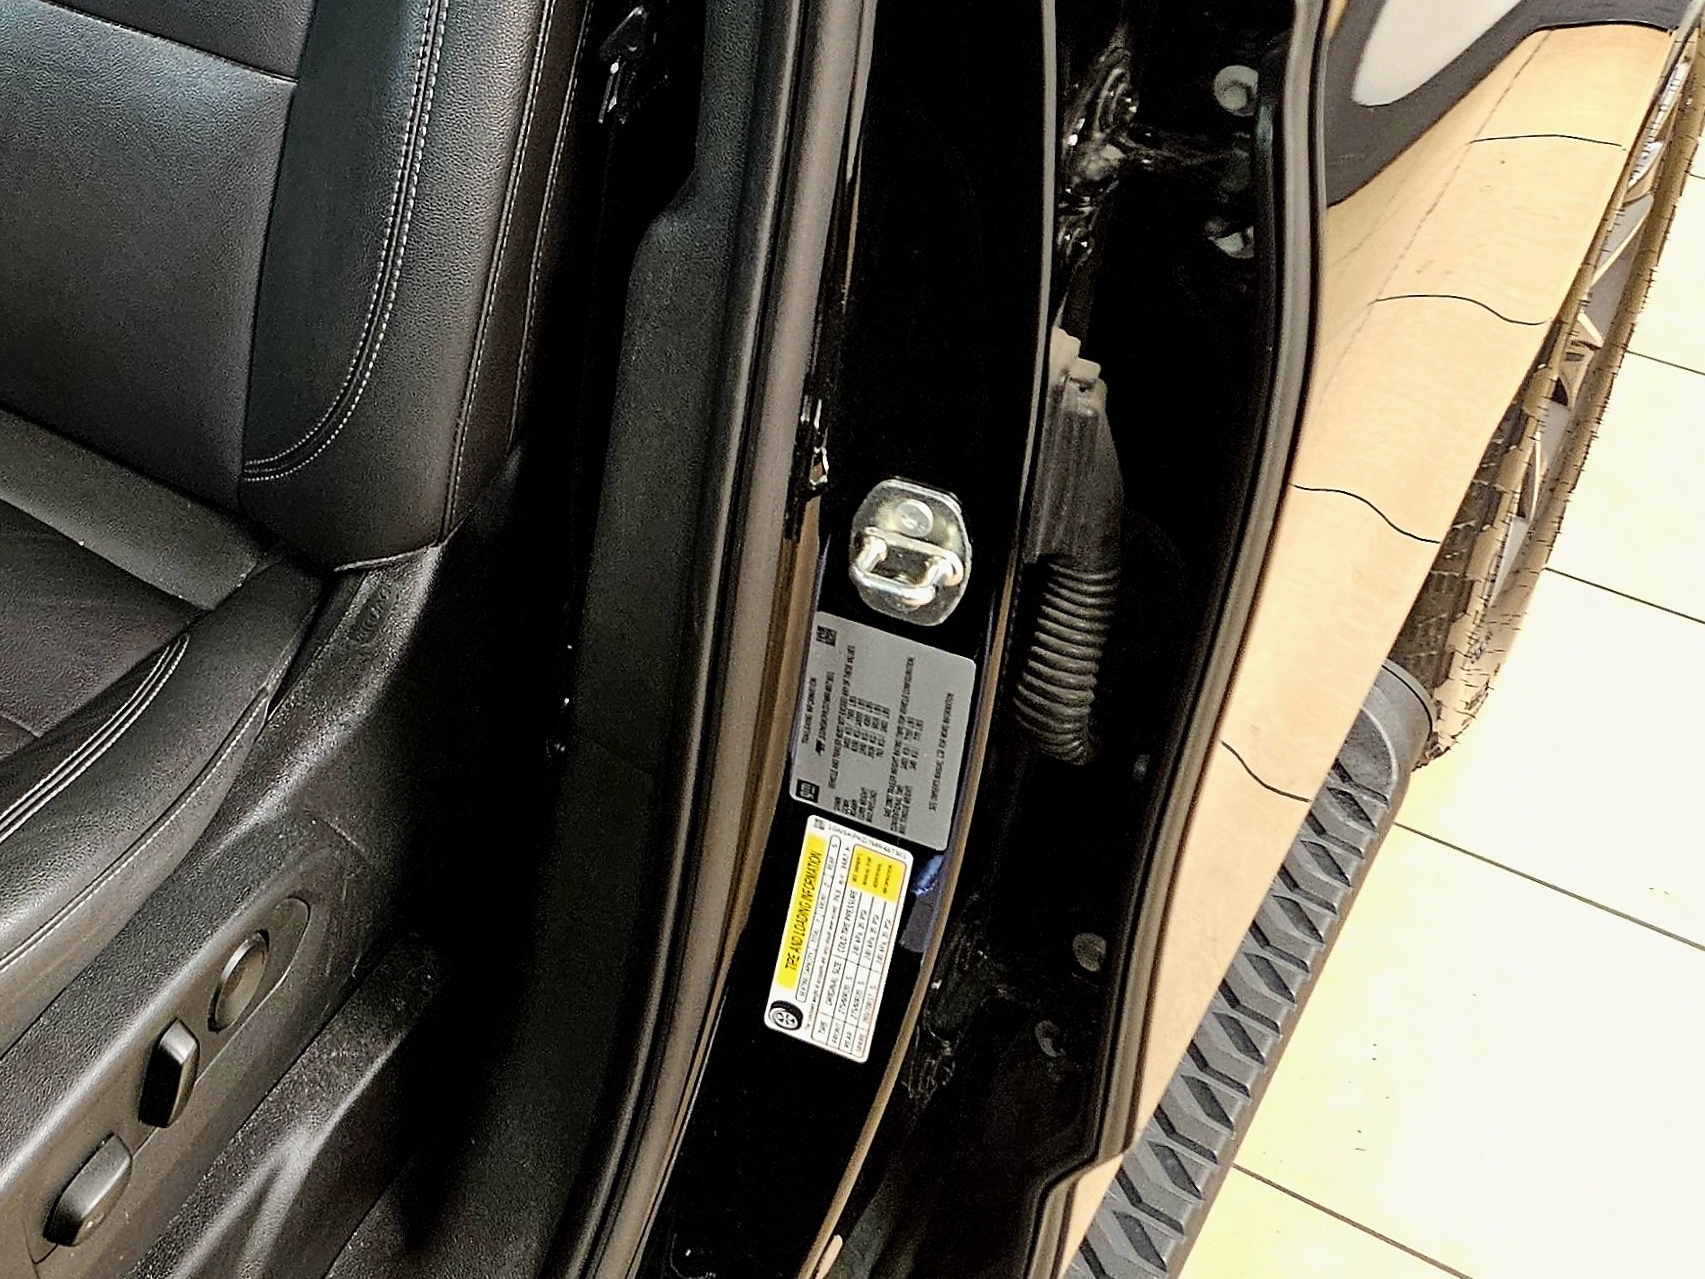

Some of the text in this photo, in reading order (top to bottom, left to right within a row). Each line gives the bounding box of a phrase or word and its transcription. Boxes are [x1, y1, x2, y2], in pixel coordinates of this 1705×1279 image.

[799, 848, 824, 902] INFORMATION
[791, 899, 812, 936] LOADING
[843, 888, 858, 922] PRESSURE
[788, 933, 804, 954] AND
[784, 951, 800, 972] TIRE
[831, 960, 842, 976] SIZE
